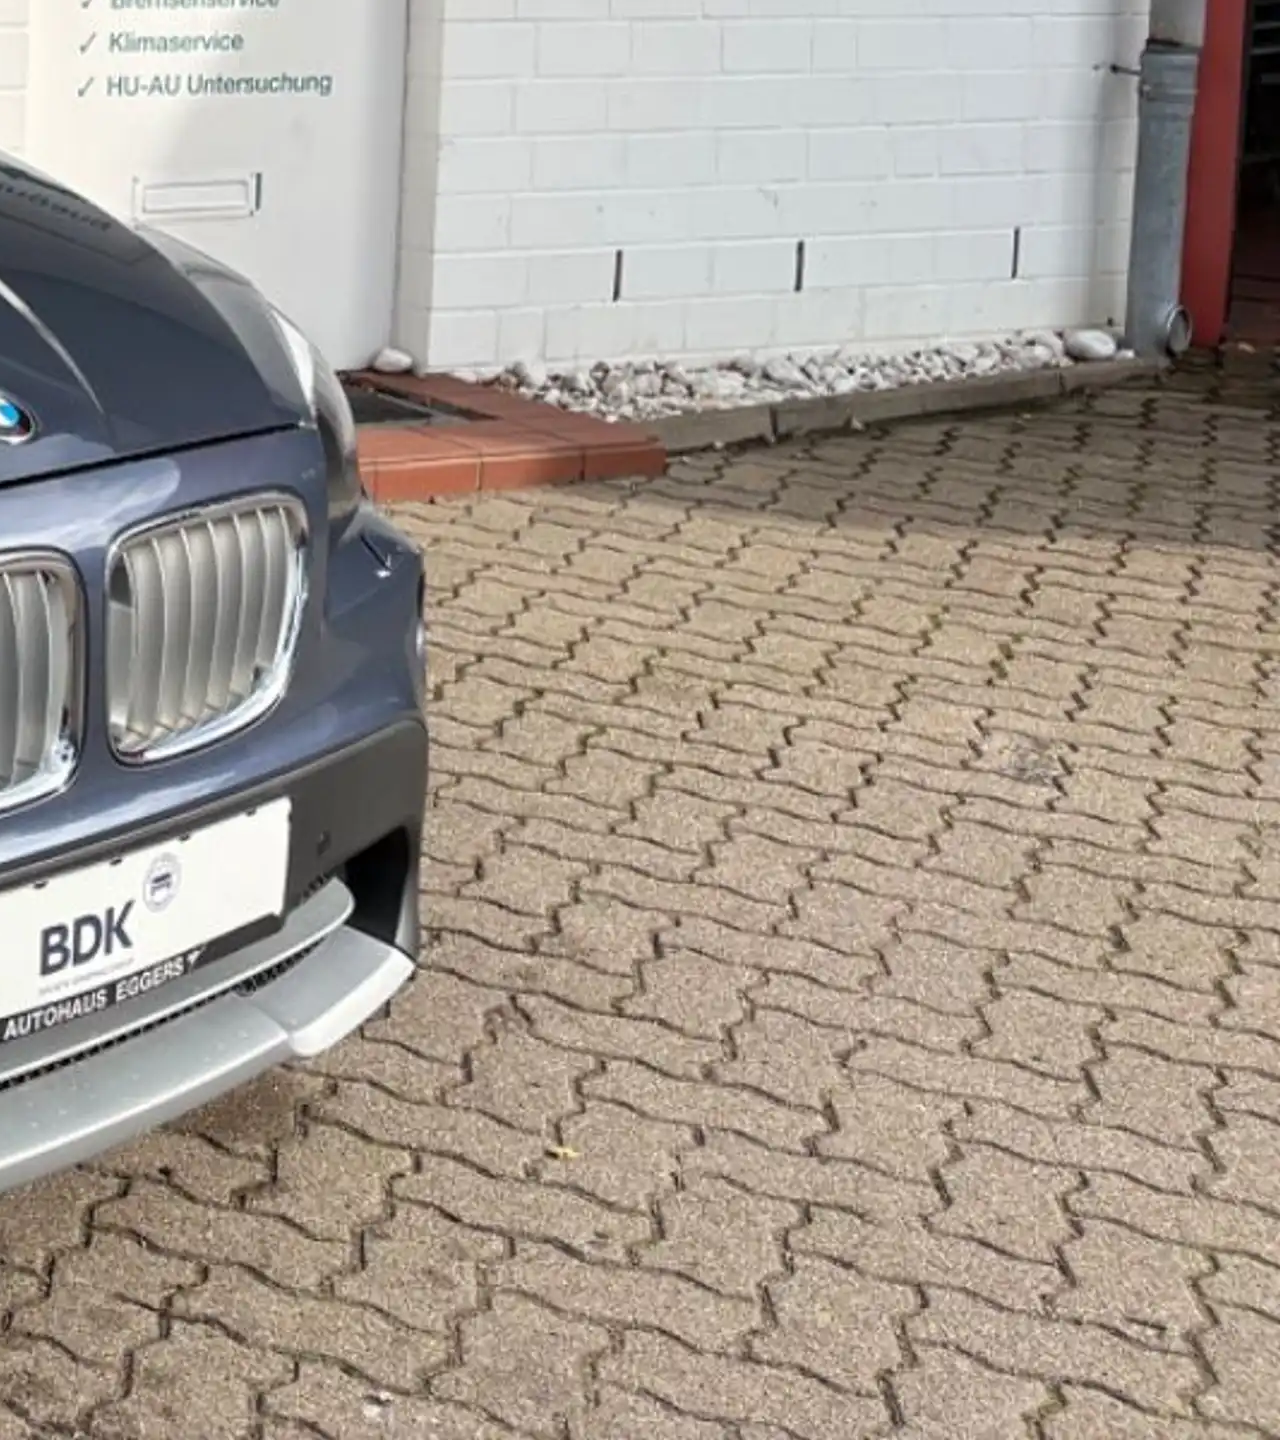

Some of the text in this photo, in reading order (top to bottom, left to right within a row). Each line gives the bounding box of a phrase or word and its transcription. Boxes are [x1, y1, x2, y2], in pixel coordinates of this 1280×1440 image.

[108, 31, 244, 53] Klimaservice
[106, 73, 333, 97] HU-AU Untersuchung
[40, 898, 134, 976] BDK
[3, 987, 108, 1041] AUTOHAUS
[115, 956, 184, 1001] EGGERS
